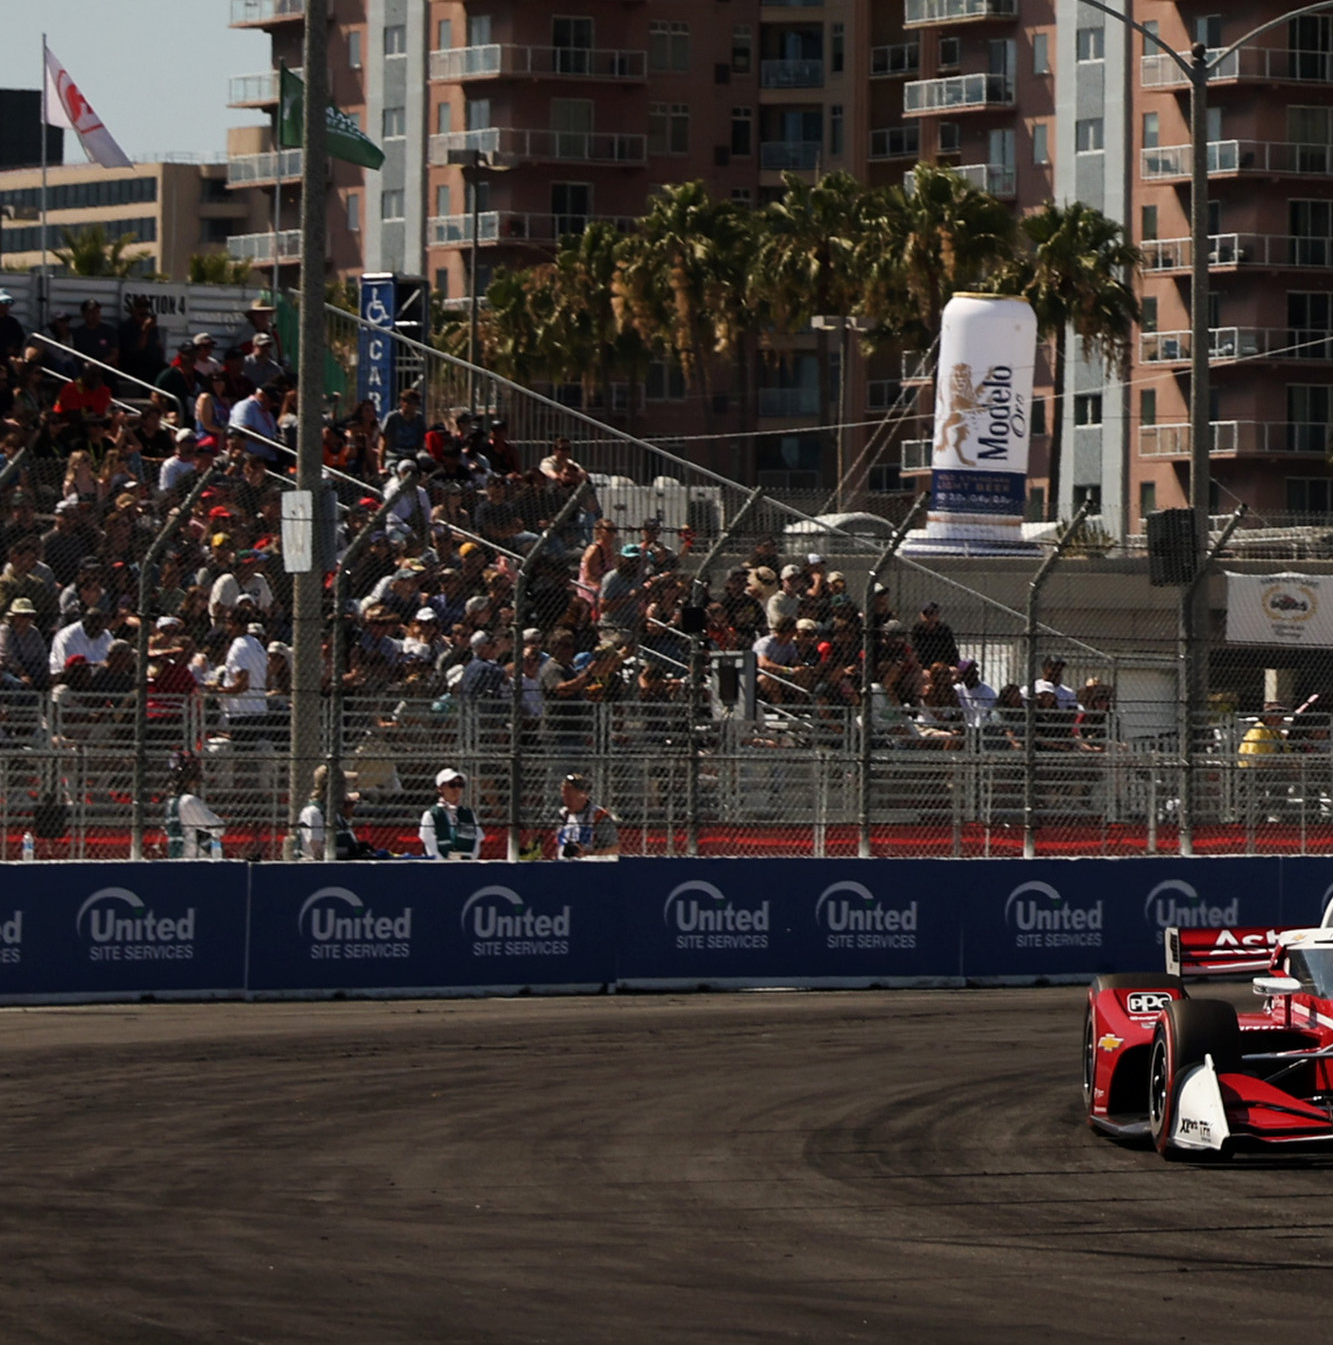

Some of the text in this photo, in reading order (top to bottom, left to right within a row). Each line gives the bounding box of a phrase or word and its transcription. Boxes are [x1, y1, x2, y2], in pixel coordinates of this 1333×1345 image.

[977, 365, 1013, 461] Modelo
[91, 908, 196, 941] United
[311, 907, 412, 940] United
[474, 905, 571, 938] United
[677, 900, 771, 932] United
[828, 901, 917, 931] United
[1016, 901, 1103, 930] United
[1157, 898, 1239, 928] United
[90, 945, 194, 961] SITE SERVICES
[310, 943, 410, 959] SITE SERVICES
[473, 940, 569, 956] SITE SERVICES
[676, 934, 769, 949] SITE SERVICES
[827, 934, 917, 949] SITE SERVICES
[1016, 933, 1102, 948] SITE SERVICES
